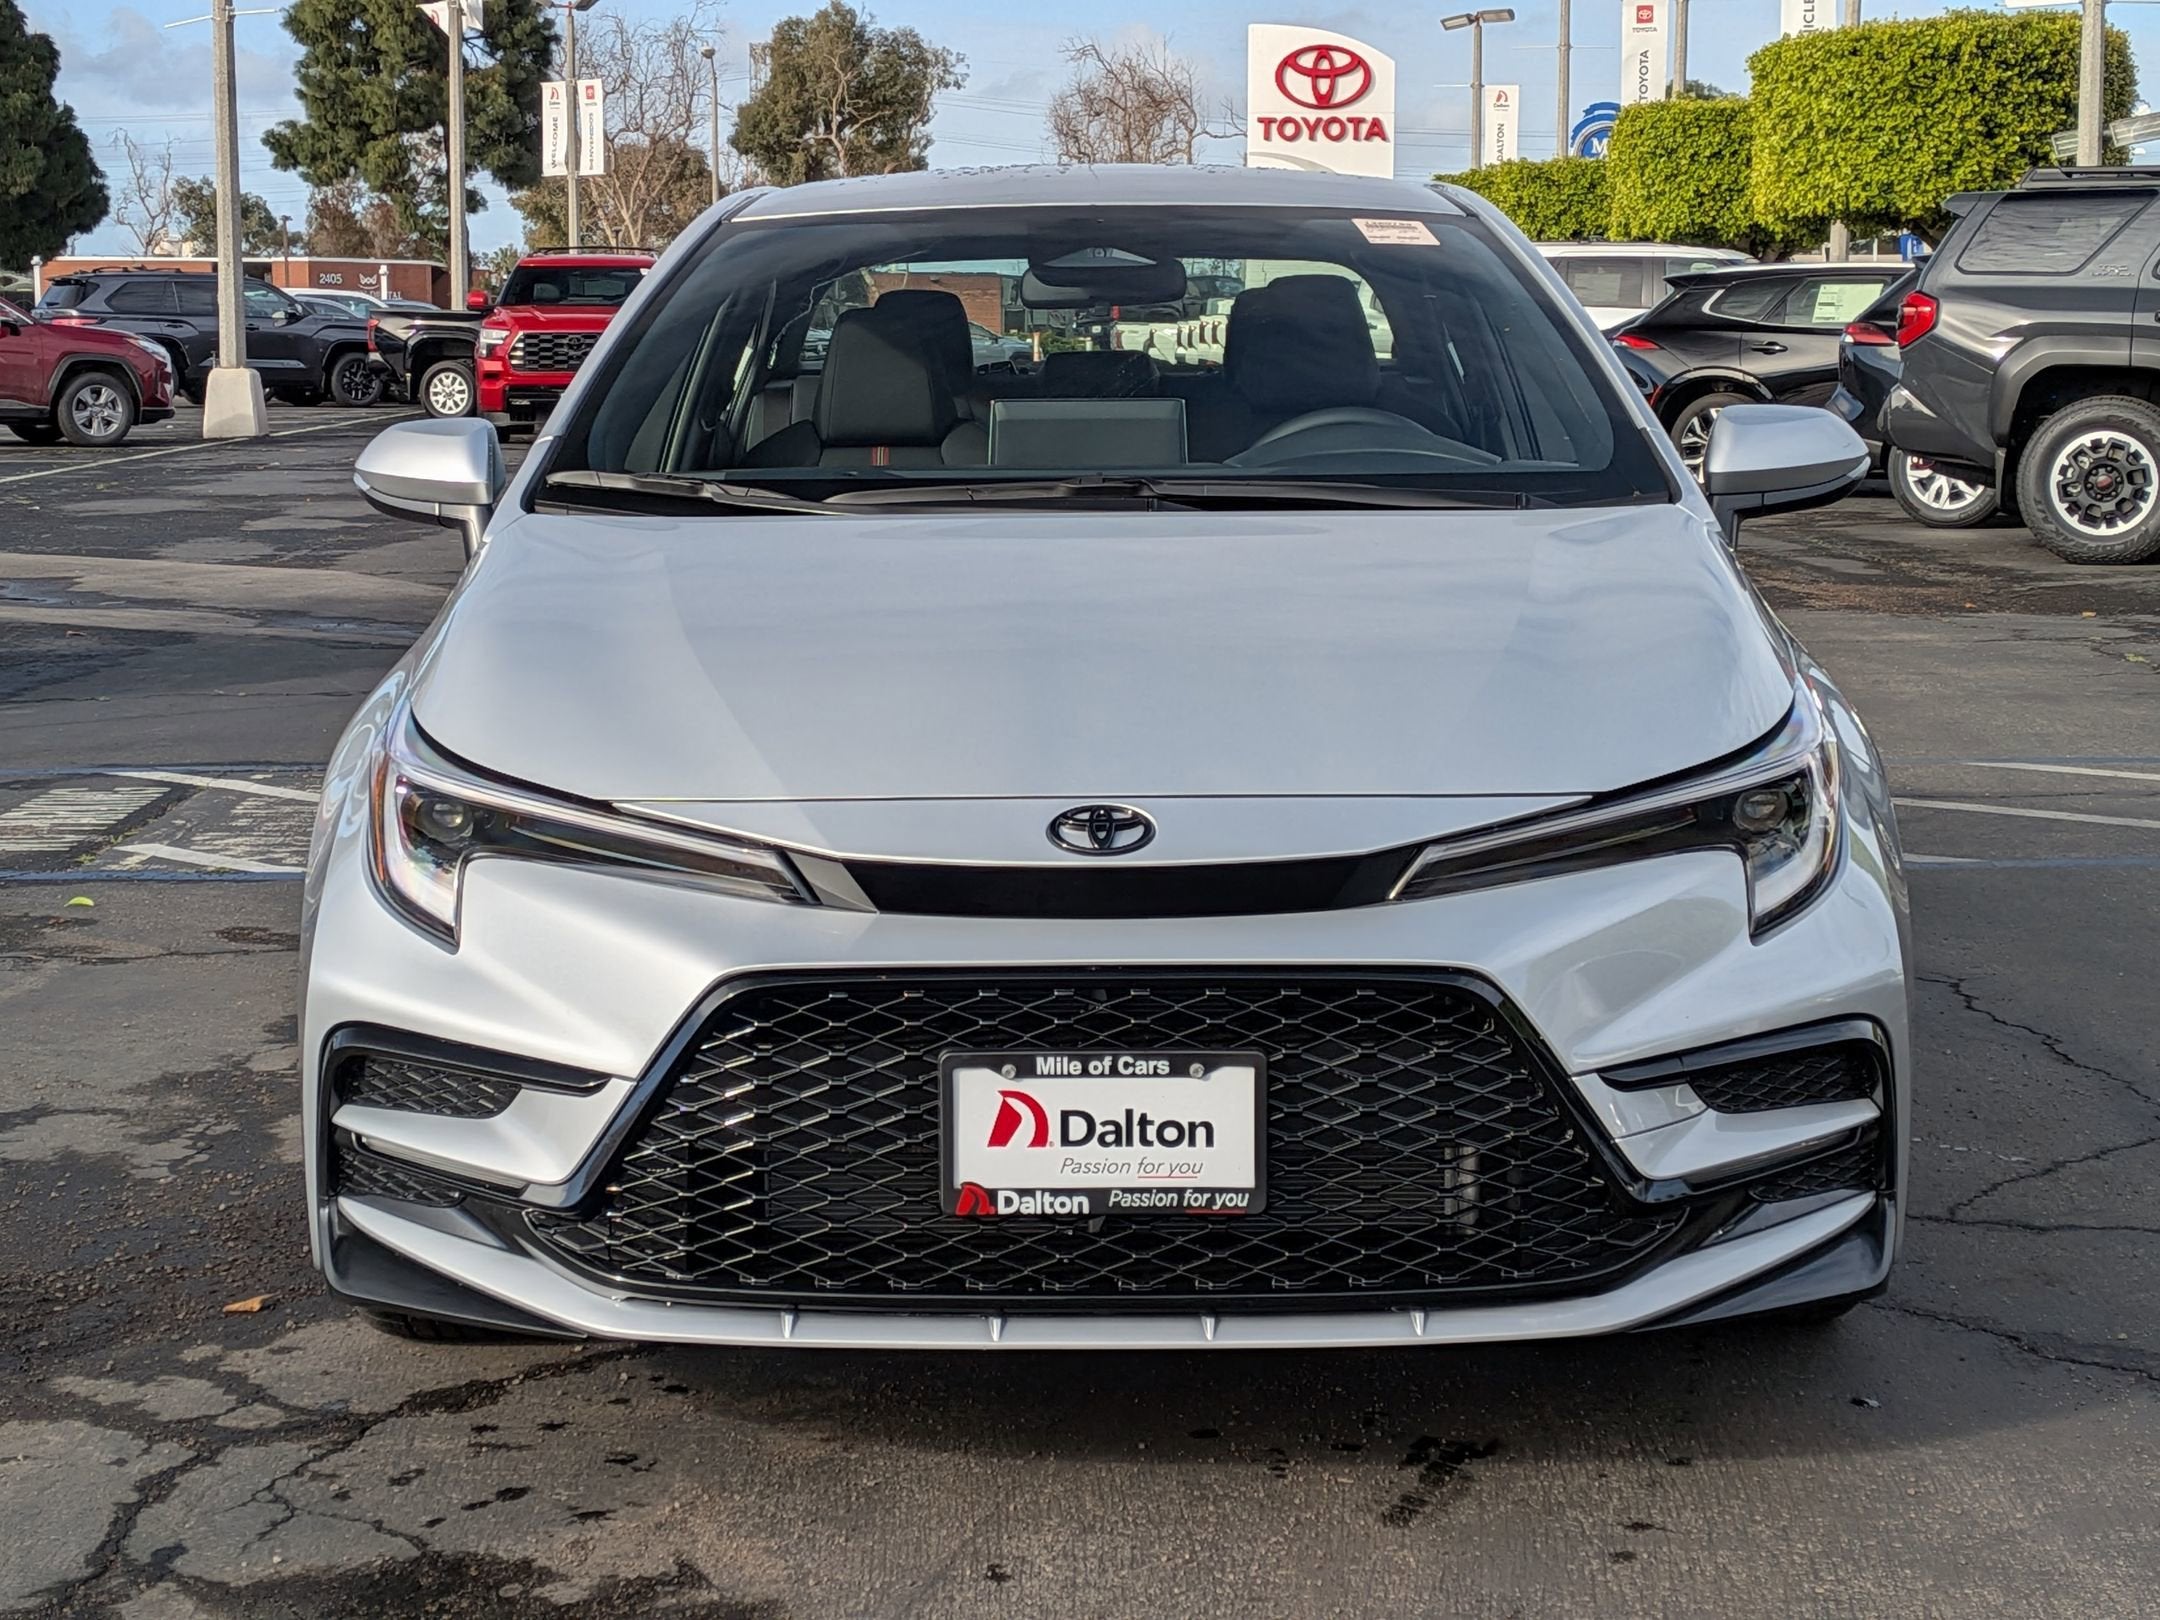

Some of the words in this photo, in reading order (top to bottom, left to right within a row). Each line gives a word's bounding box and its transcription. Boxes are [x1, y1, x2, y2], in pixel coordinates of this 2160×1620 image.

[1639, 50, 1650, 103] TOYOTA
[551, 117, 559, 169] WELCOME
[1257, 116, 1388, 143] TOYOTA
[1496, 123, 1505, 162] DALTON
[319, 273, 343, 285] 2405
[1036, 1056, 1082, 1076] Mile
[1088, 1055, 1113, 1076] of
[1117, 1056, 1170, 1076] Cars
[1060, 1109, 1215, 1148] Dalton
[1060, 1157, 1131, 1175] Passion
[1137, 1157, 1165, 1175] for
[1168, 1161, 1204, 1177] you
[997, 1190, 1090, 1215] Dalton
[1108, 1189, 1178, 1208] Passion
[1183, 1189, 1212, 1208] for
[1211, 1192, 1250, 1211] you
